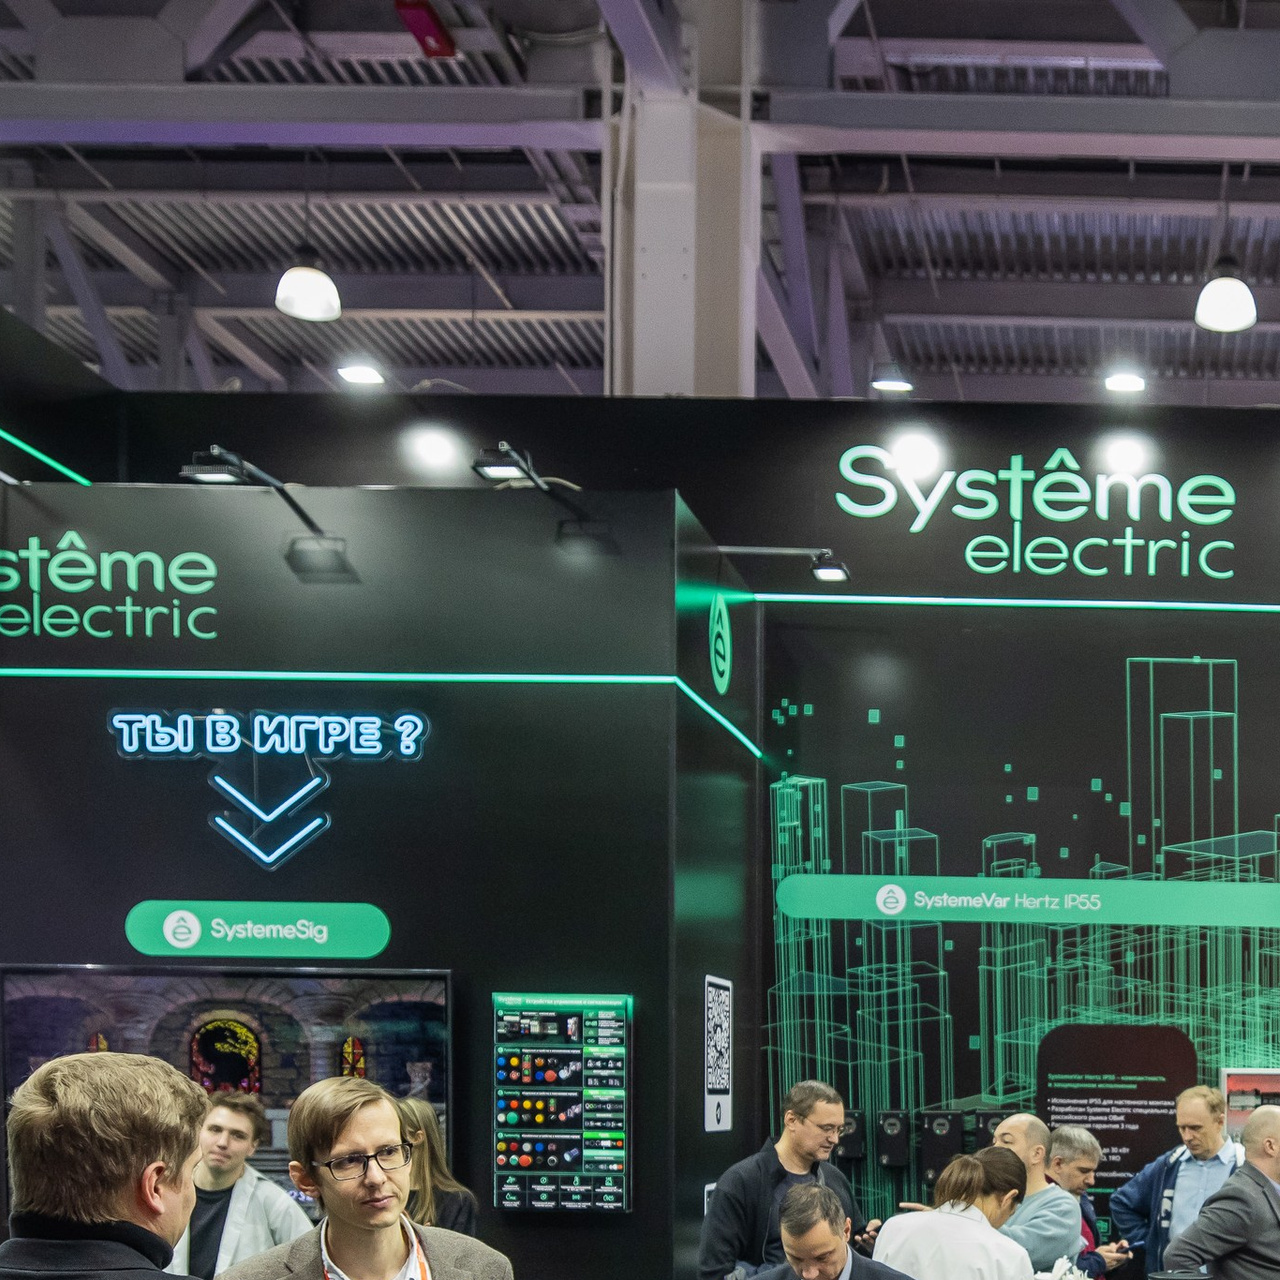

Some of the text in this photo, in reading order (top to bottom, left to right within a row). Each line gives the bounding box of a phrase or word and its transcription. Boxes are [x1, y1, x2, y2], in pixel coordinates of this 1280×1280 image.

[835, 445, 1235, 533] Systême
[0, 530, 217, 593] stême
[964, 522, 1235, 580] electric
[113, 714, 424, 755] ТЫ В ИГРЕ ?
[914, 891, 1010, 914] SystemeVar
[1015, 892, 1060, 912] Hertz
[1064, 892, 1101, 912] IP55
[210, 919, 328, 943] SystemeSig
